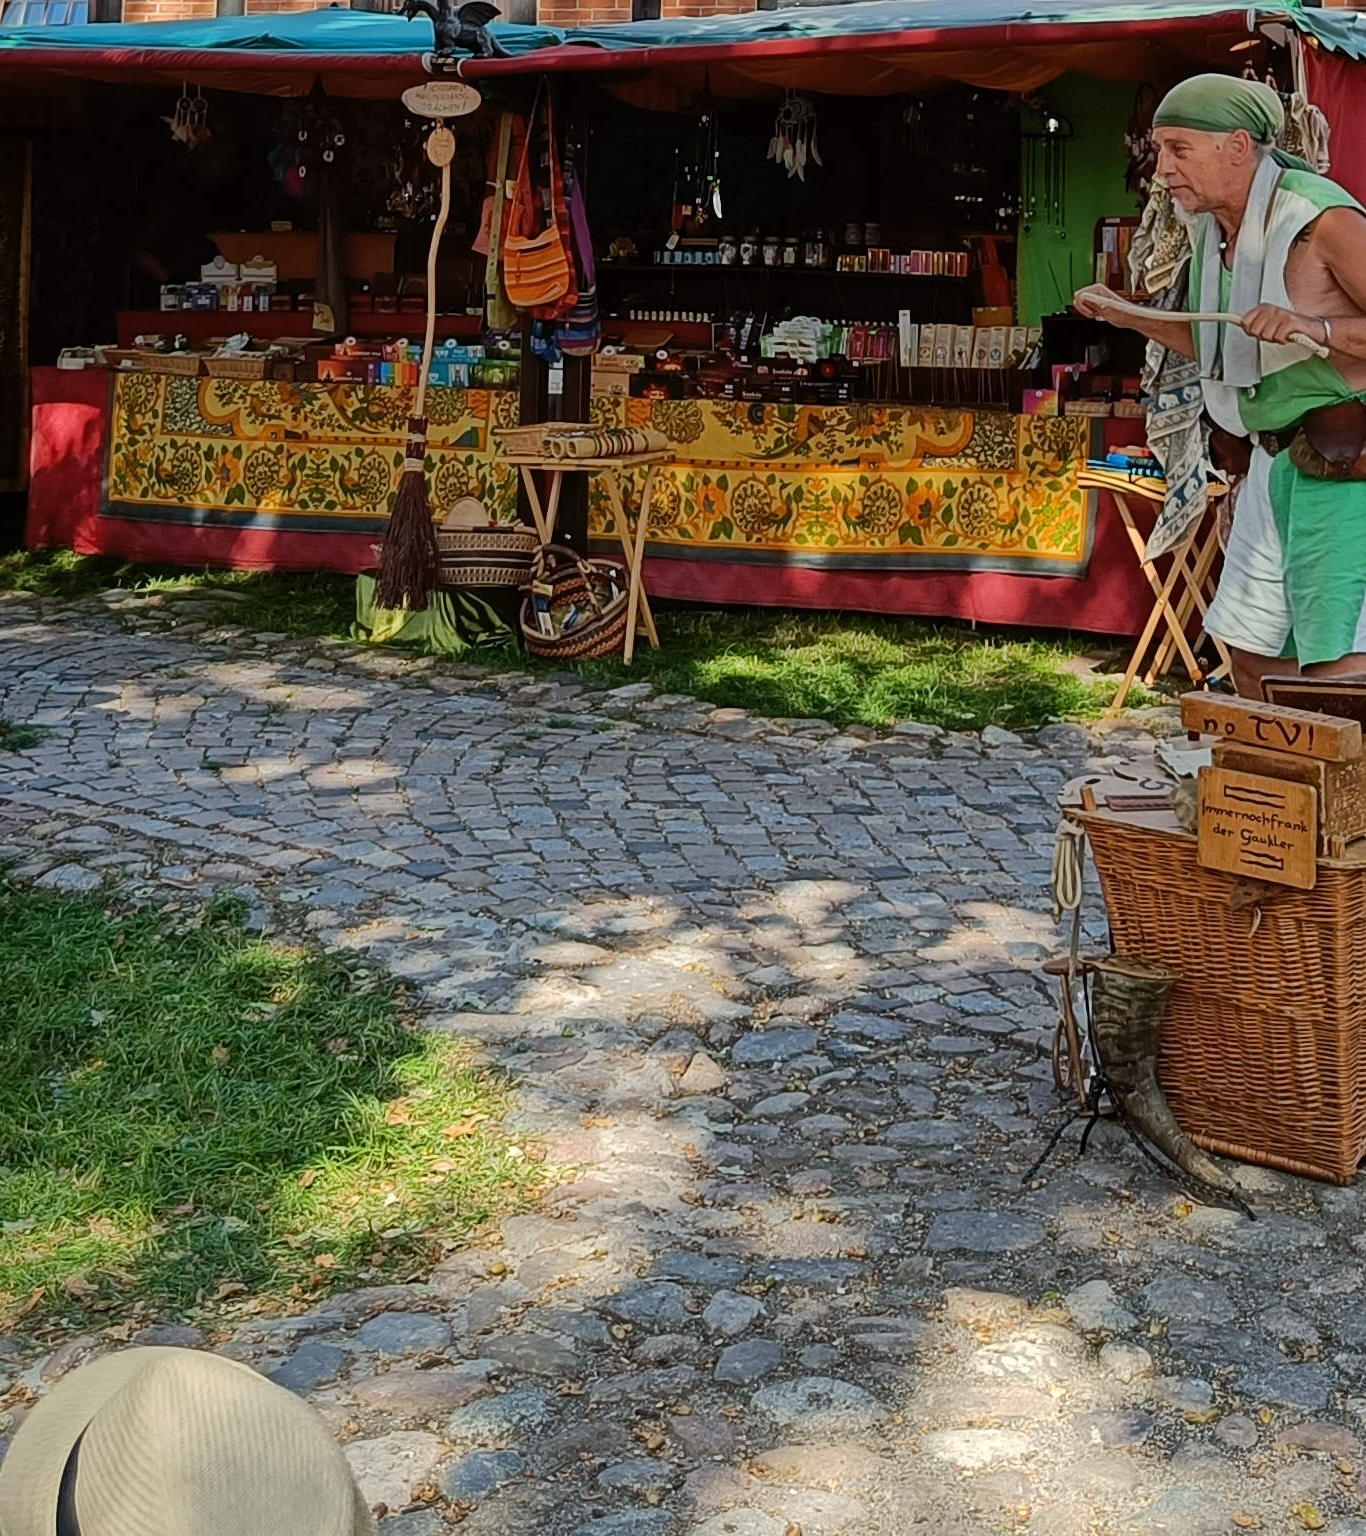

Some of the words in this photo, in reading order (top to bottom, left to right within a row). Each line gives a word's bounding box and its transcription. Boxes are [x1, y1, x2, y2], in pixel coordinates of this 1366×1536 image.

[1203, 717, 1236, 736] no
[1248, 714, 1315, 751] TV!
[1202, 798, 1308, 833] Immernochfrank
[1212, 823, 1235, 837] der
[1240, 828, 1295, 851] Gaukler
